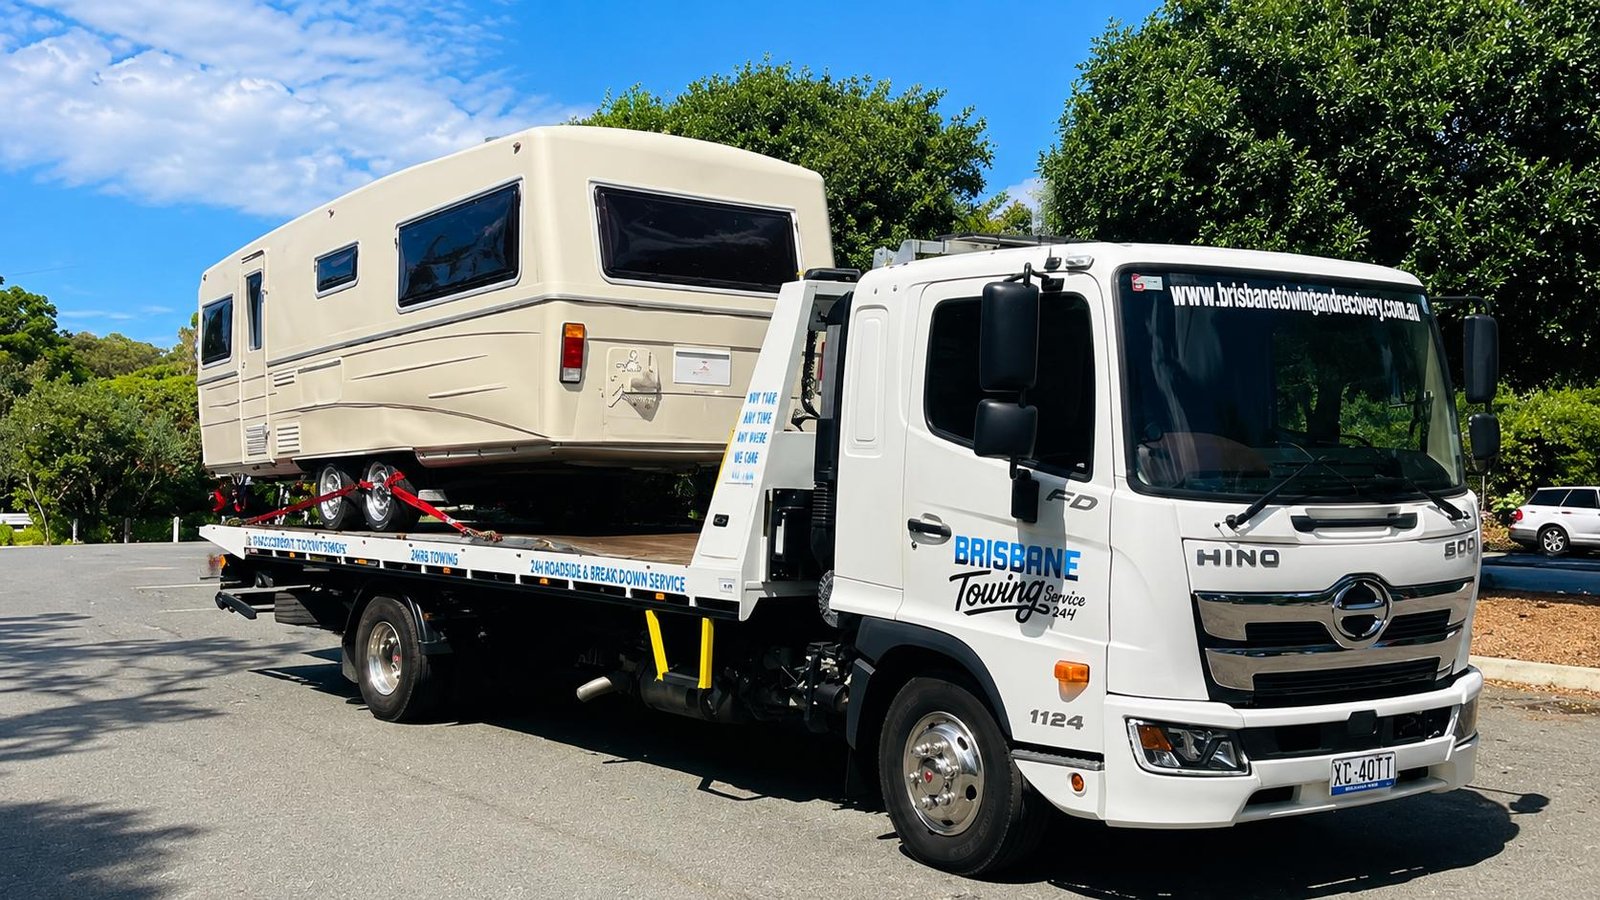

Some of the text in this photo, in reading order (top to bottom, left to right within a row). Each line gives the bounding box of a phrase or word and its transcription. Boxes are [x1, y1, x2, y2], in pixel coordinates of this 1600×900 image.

[1170, 282, 1420, 321] www.brisbanetowingandrecovery.com.au
[1046, 489, 1098, 511] FD
[429, 551, 459, 566] TOWING
[954, 536, 1081, 581] BRISBANE
[1197, 549, 1280, 568] HINO
[1444, 537, 1475, 558] 500
[544, 560, 581, 579] ROADSIDE
[582, 565, 589, 580] &
[619, 569, 647, 587] DOWN
[649, 572, 686, 592] SERVICE
[949, 570, 1086, 624] Towing Service
[1030, 709, 1084, 730] 1124
